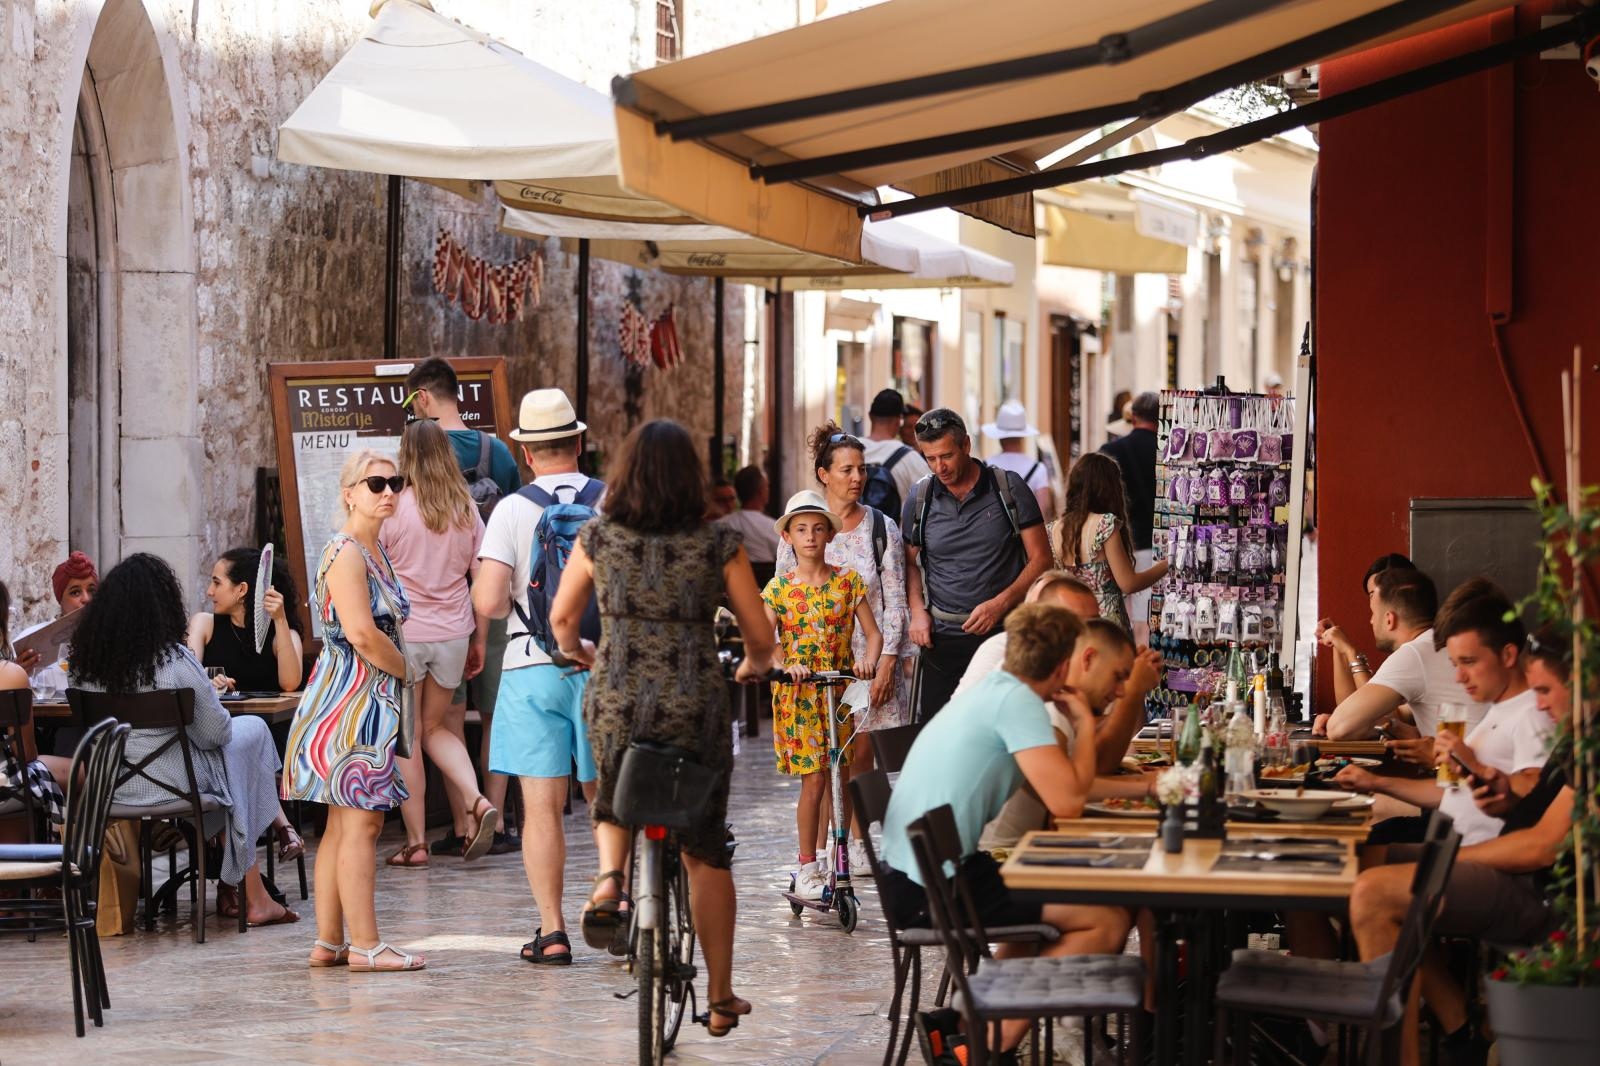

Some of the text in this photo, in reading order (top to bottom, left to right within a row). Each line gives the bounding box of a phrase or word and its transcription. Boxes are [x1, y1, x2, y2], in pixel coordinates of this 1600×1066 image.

[298, 384, 482, 408] RESTAUT
[301, 411, 373, 429] Misterija
[301, 433, 350, 449] MENU
